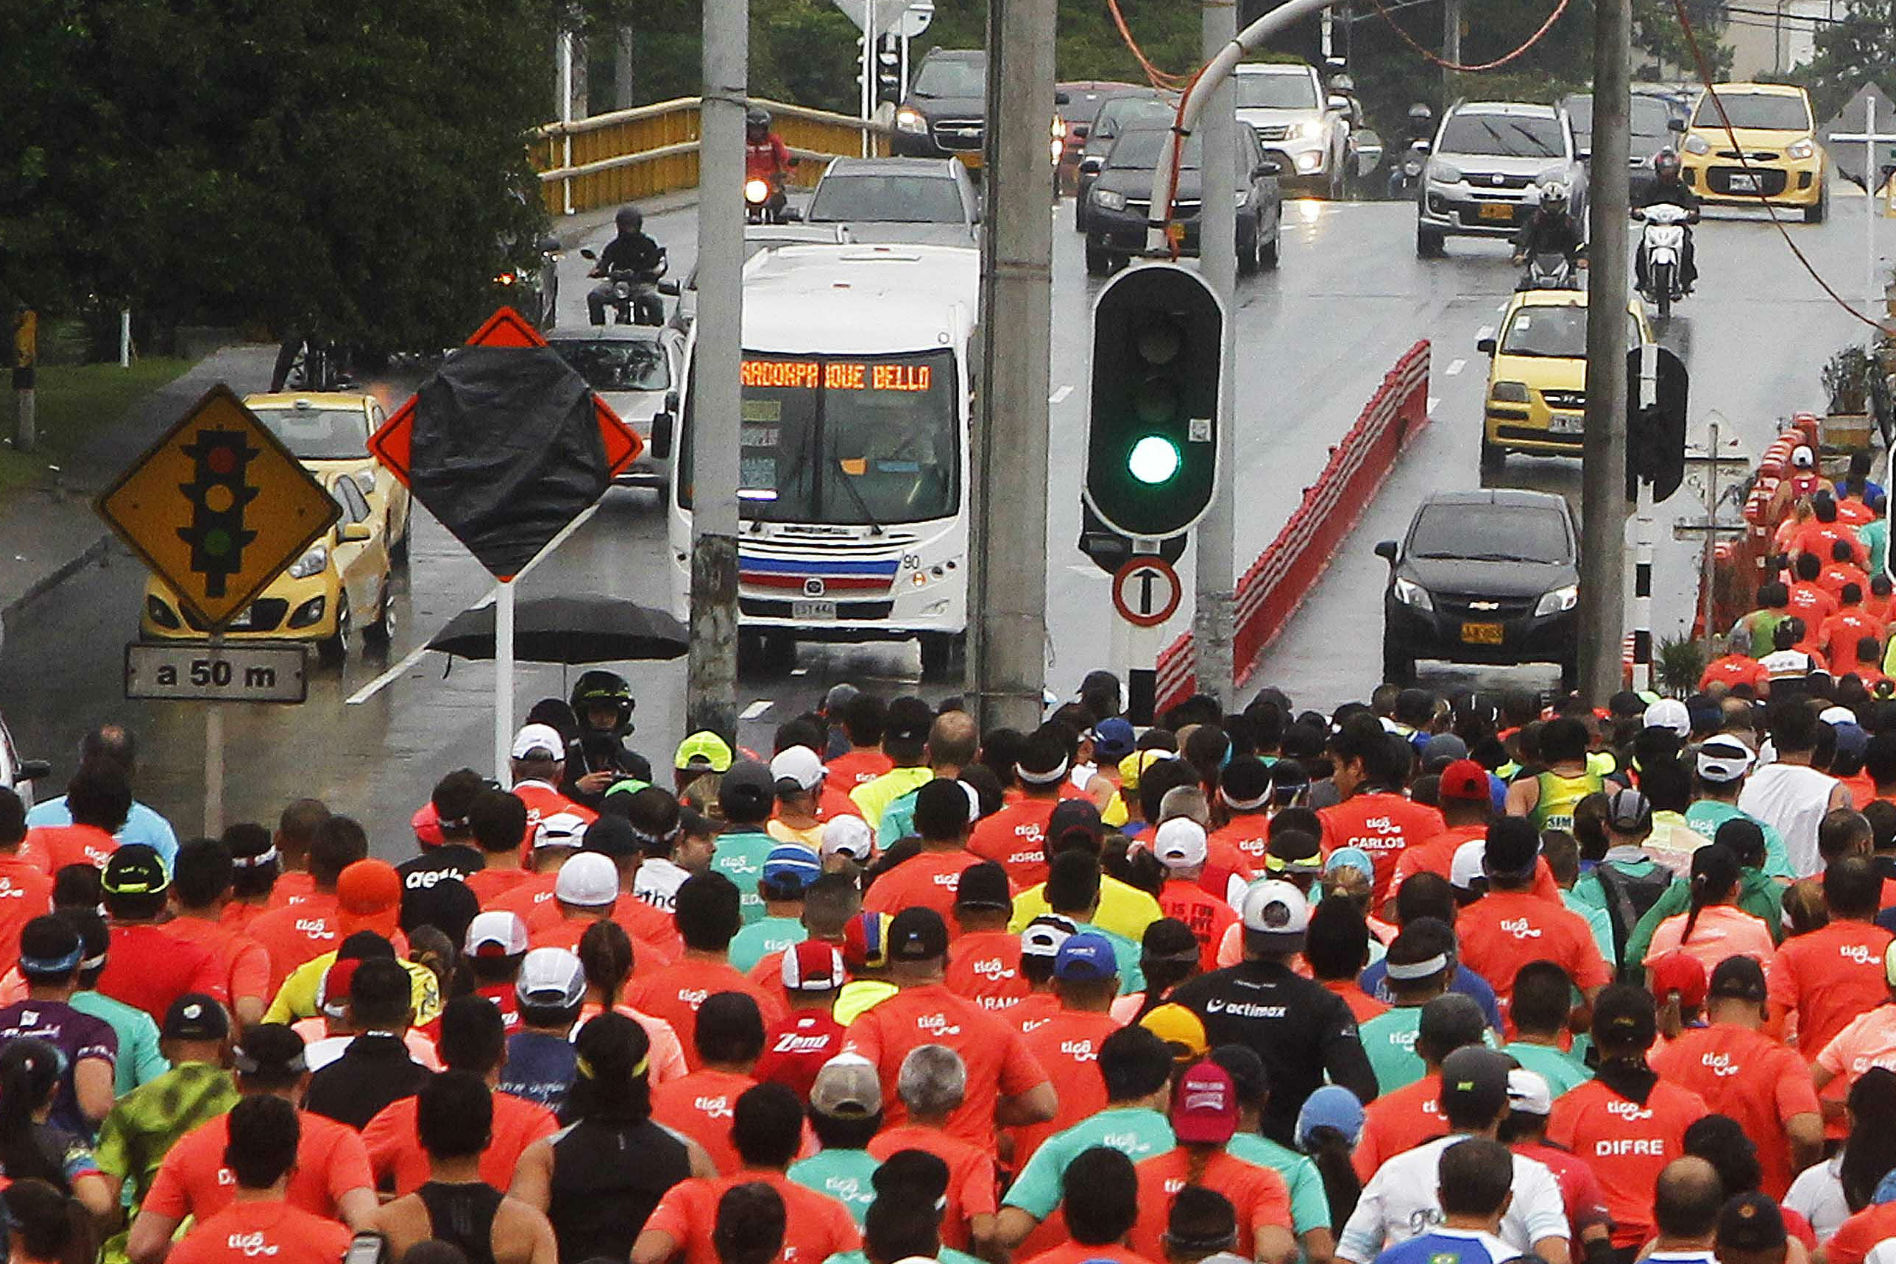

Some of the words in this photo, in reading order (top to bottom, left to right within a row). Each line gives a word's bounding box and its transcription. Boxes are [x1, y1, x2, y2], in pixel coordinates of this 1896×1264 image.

[872, 364, 930, 390] BELLO
[157, 664, 178, 686] a
[190, 659, 232, 685] 50
[244, 662, 277, 688] m
[1347, 836, 1407, 850] CARLOS
[1226, 1003, 1288, 1018] actimax
[1596, 1139, 1664, 1156] DIFRE
